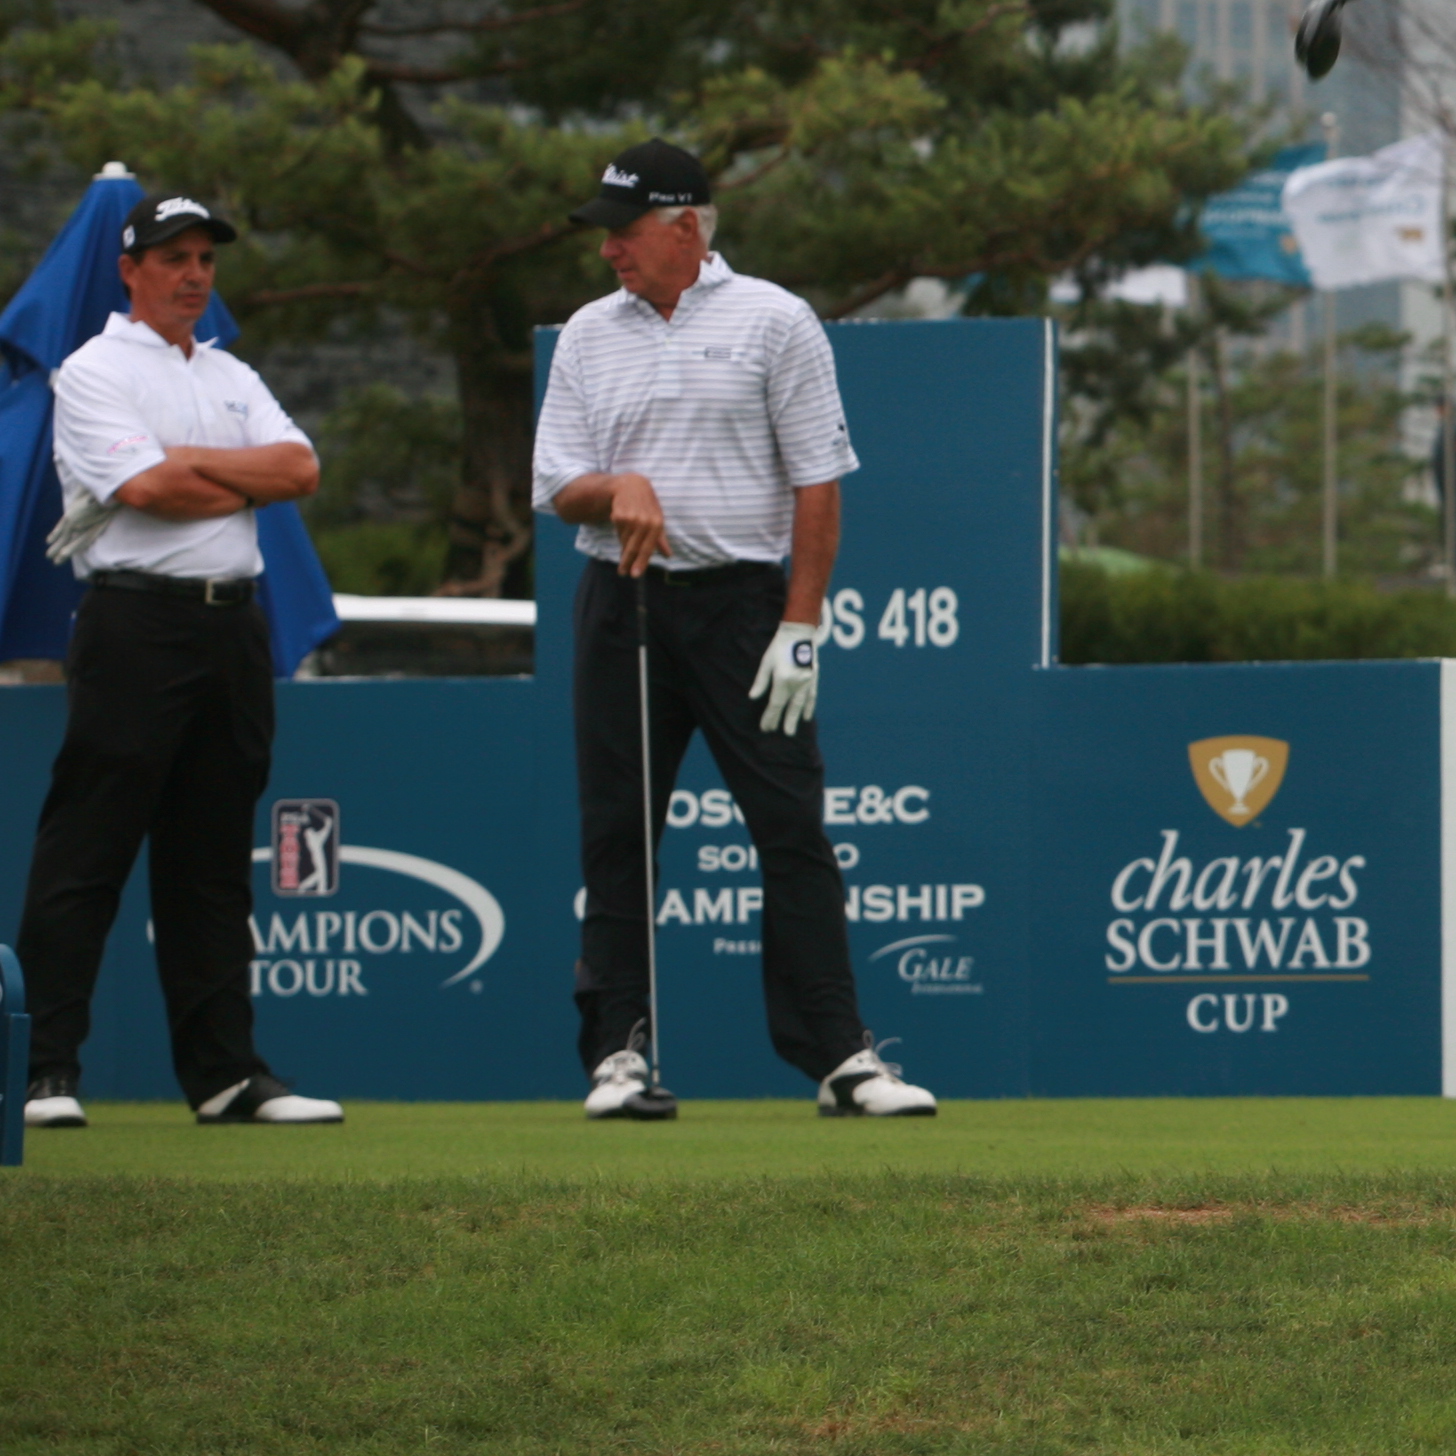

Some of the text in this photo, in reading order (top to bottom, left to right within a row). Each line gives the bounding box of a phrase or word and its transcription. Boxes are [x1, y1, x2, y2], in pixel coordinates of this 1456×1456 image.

[878, 586, 960, 648] 418
[823, 785, 930, 825] E&C
[1110, 827, 1367, 913] charles
[1105, 916, 1372, 972] SCHWAB
[249, 958, 368, 997] TOUR
[1186, 993, 1289, 1033] CUP
